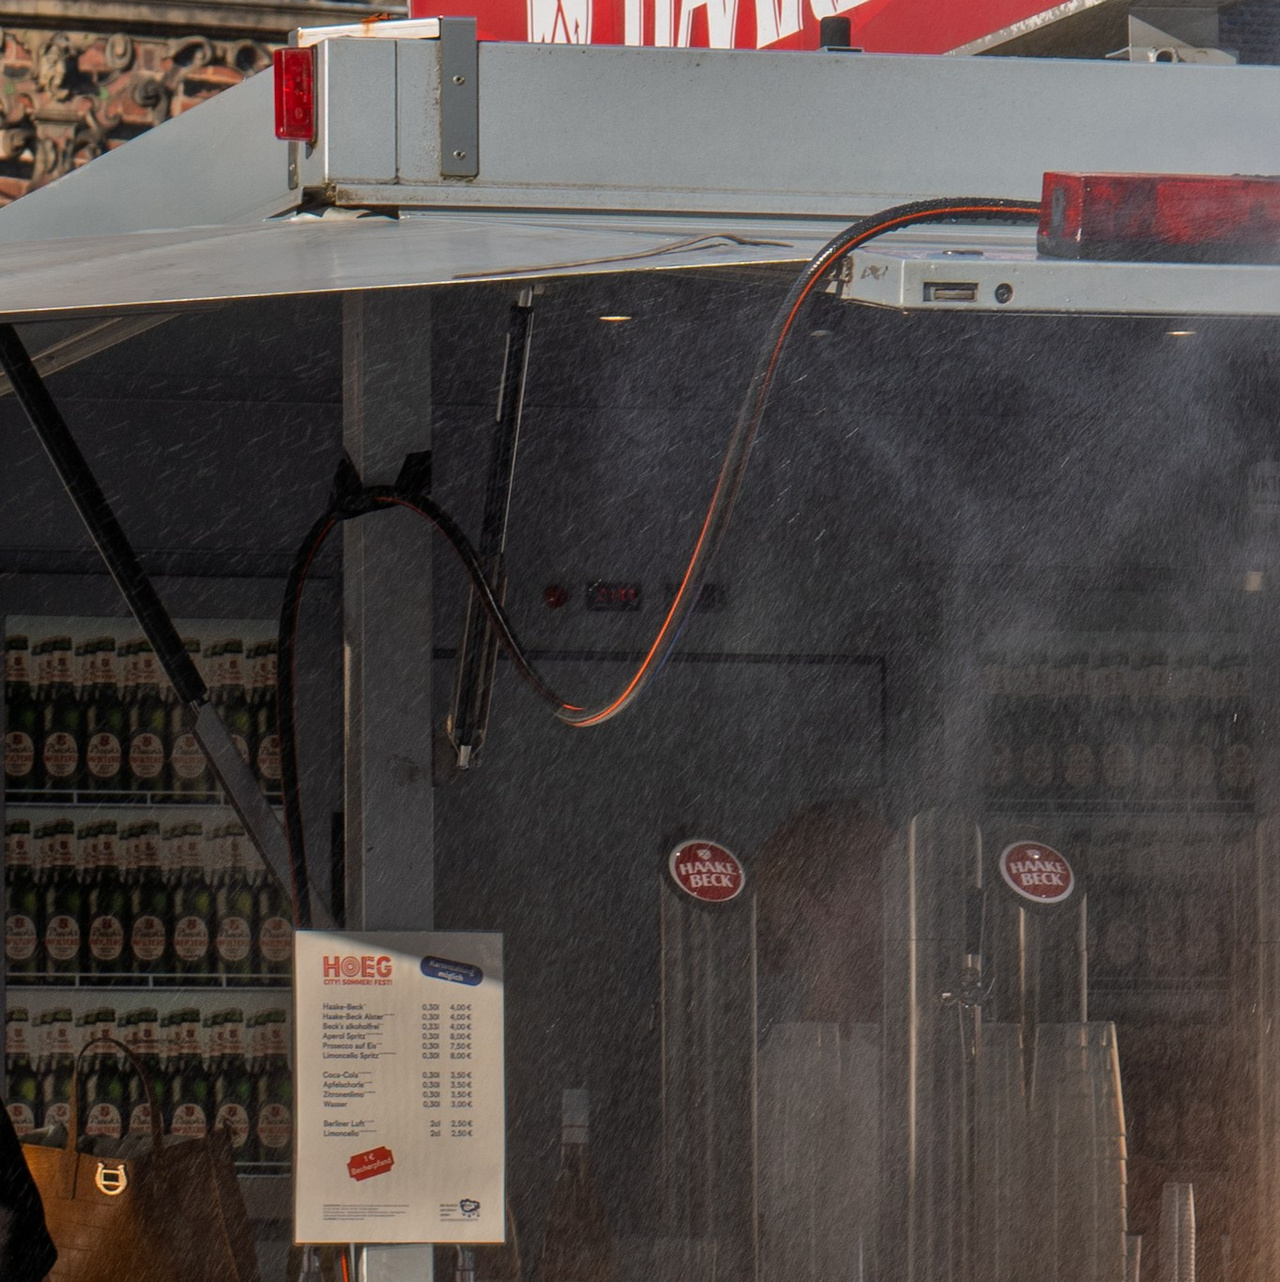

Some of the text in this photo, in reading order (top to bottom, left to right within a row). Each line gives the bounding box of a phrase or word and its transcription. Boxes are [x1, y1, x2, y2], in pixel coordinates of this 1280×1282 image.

[679, 861, 736, 875] HAAKE
[1009, 860, 1066, 874] HAAKE
[690, 874, 734, 888] BECK
[1021, 873, 1064, 886] BECK
[323, 956, 392, 977] HOEG
[360, 1052, 379, 1060] Spritz
